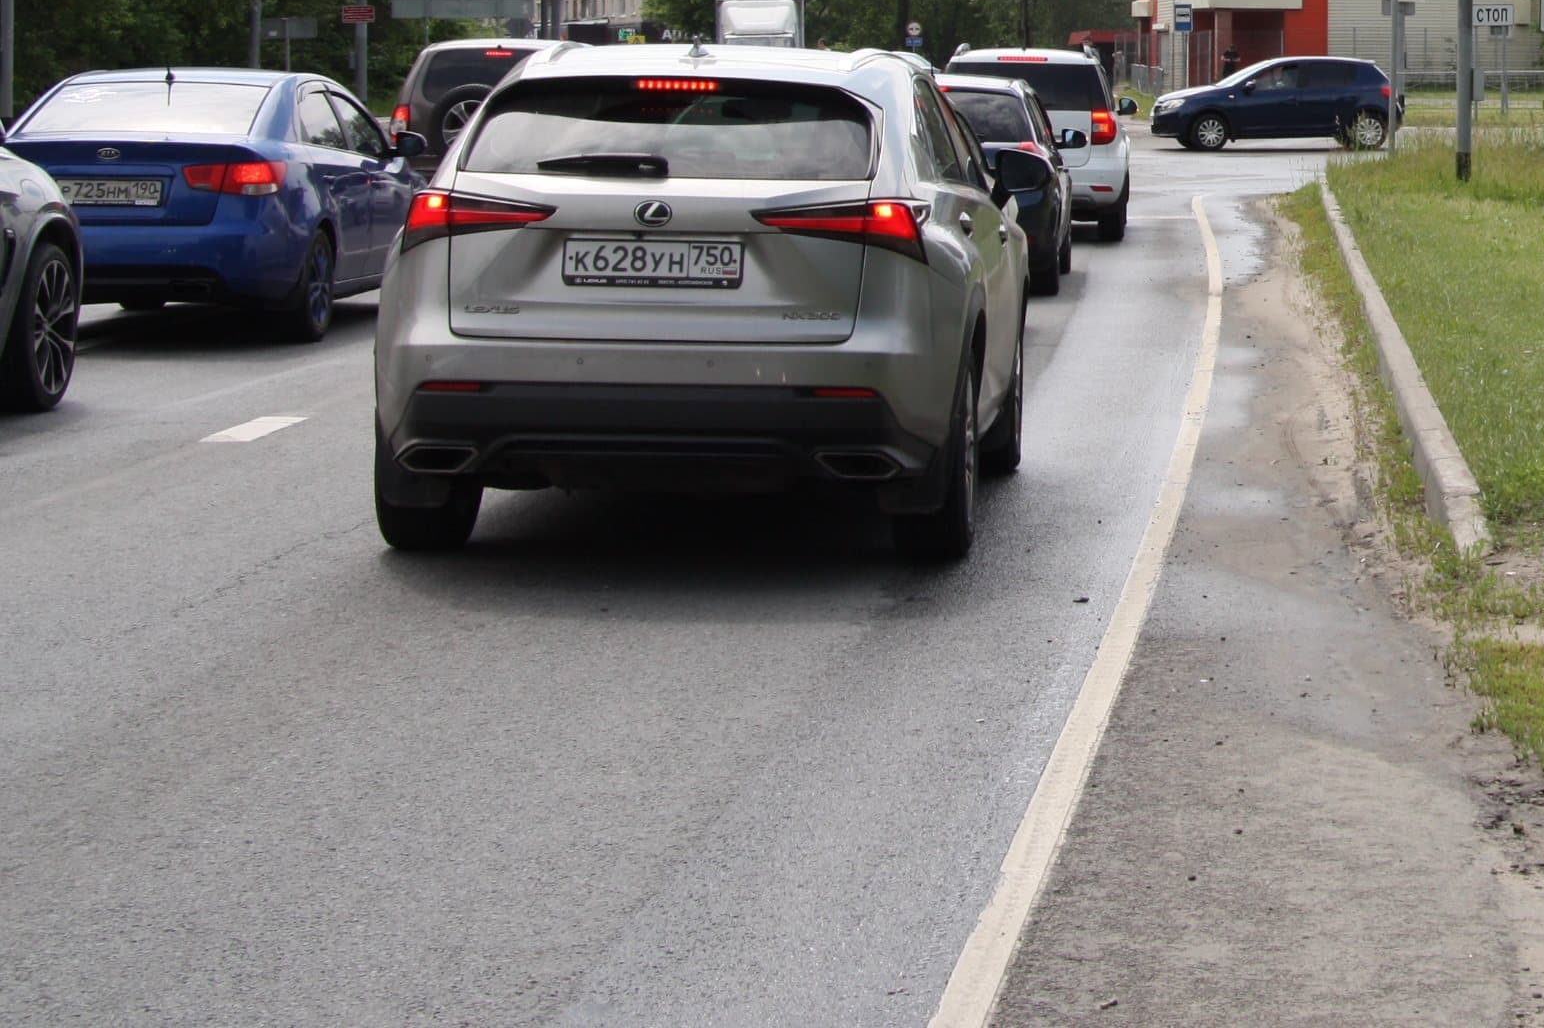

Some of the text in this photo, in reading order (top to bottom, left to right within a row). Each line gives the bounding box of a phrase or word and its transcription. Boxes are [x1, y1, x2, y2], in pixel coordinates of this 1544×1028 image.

[1476, 7, 1508, 23] СТОП
[692, 245, 733, 267] 750
[701, 267, 721, 275] RUS
